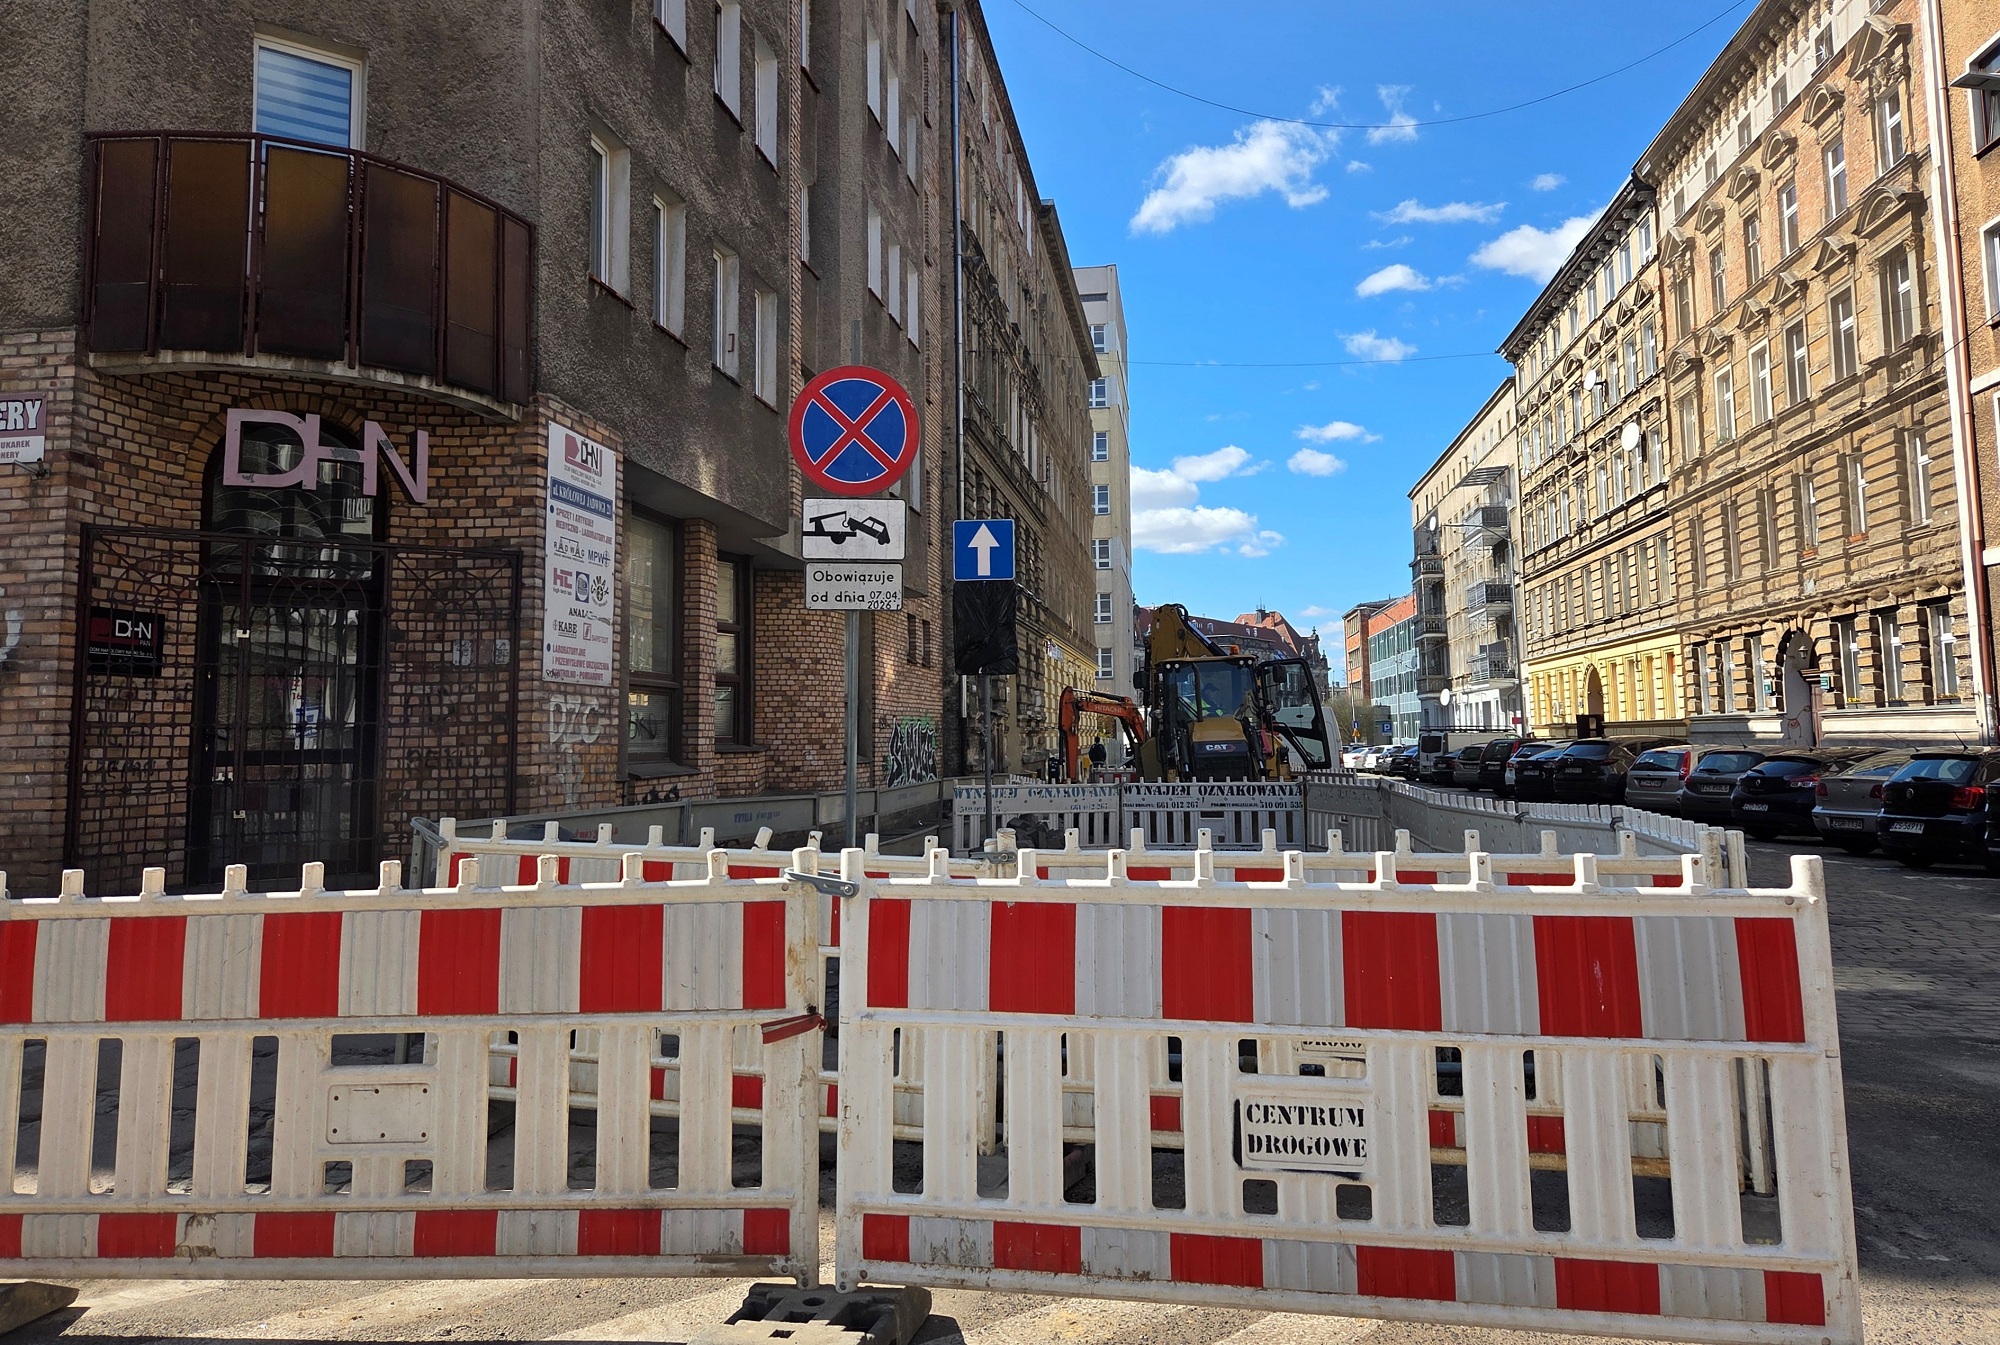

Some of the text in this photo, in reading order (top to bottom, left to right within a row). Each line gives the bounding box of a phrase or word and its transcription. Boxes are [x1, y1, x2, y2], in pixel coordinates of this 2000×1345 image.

[223, 408, 429, 504] DHN
[580, 440, 599, 470] DHN
[813, 570, 895, 585] Obowiązuje
[811, 591, 829, 602] od
[834, 591, 866, 602] dnia
[867, 601, 892, 610] 2026
[115, 619, 152, 639] DHN
[558, 621, 578, 634] KABE
[1094, 704, 1122, 713] HITACHI
[1384, 723, 1391, 732] P
[1123, 784, 1303, 796] WYNAJEM OZNAKOWANIA
[1156, 801, 1169, 809] 661
[1171, 801, 1185, 809] 012
[1260, 800, 1273, 809] 510
[1275, 801, 1288, 809] 091
[1290, 801, 1303, 809] 535
[1246, 1103, 1365, 1127] CENTRUM
[1247, 1133, 1367, 1158] DROGOWE
